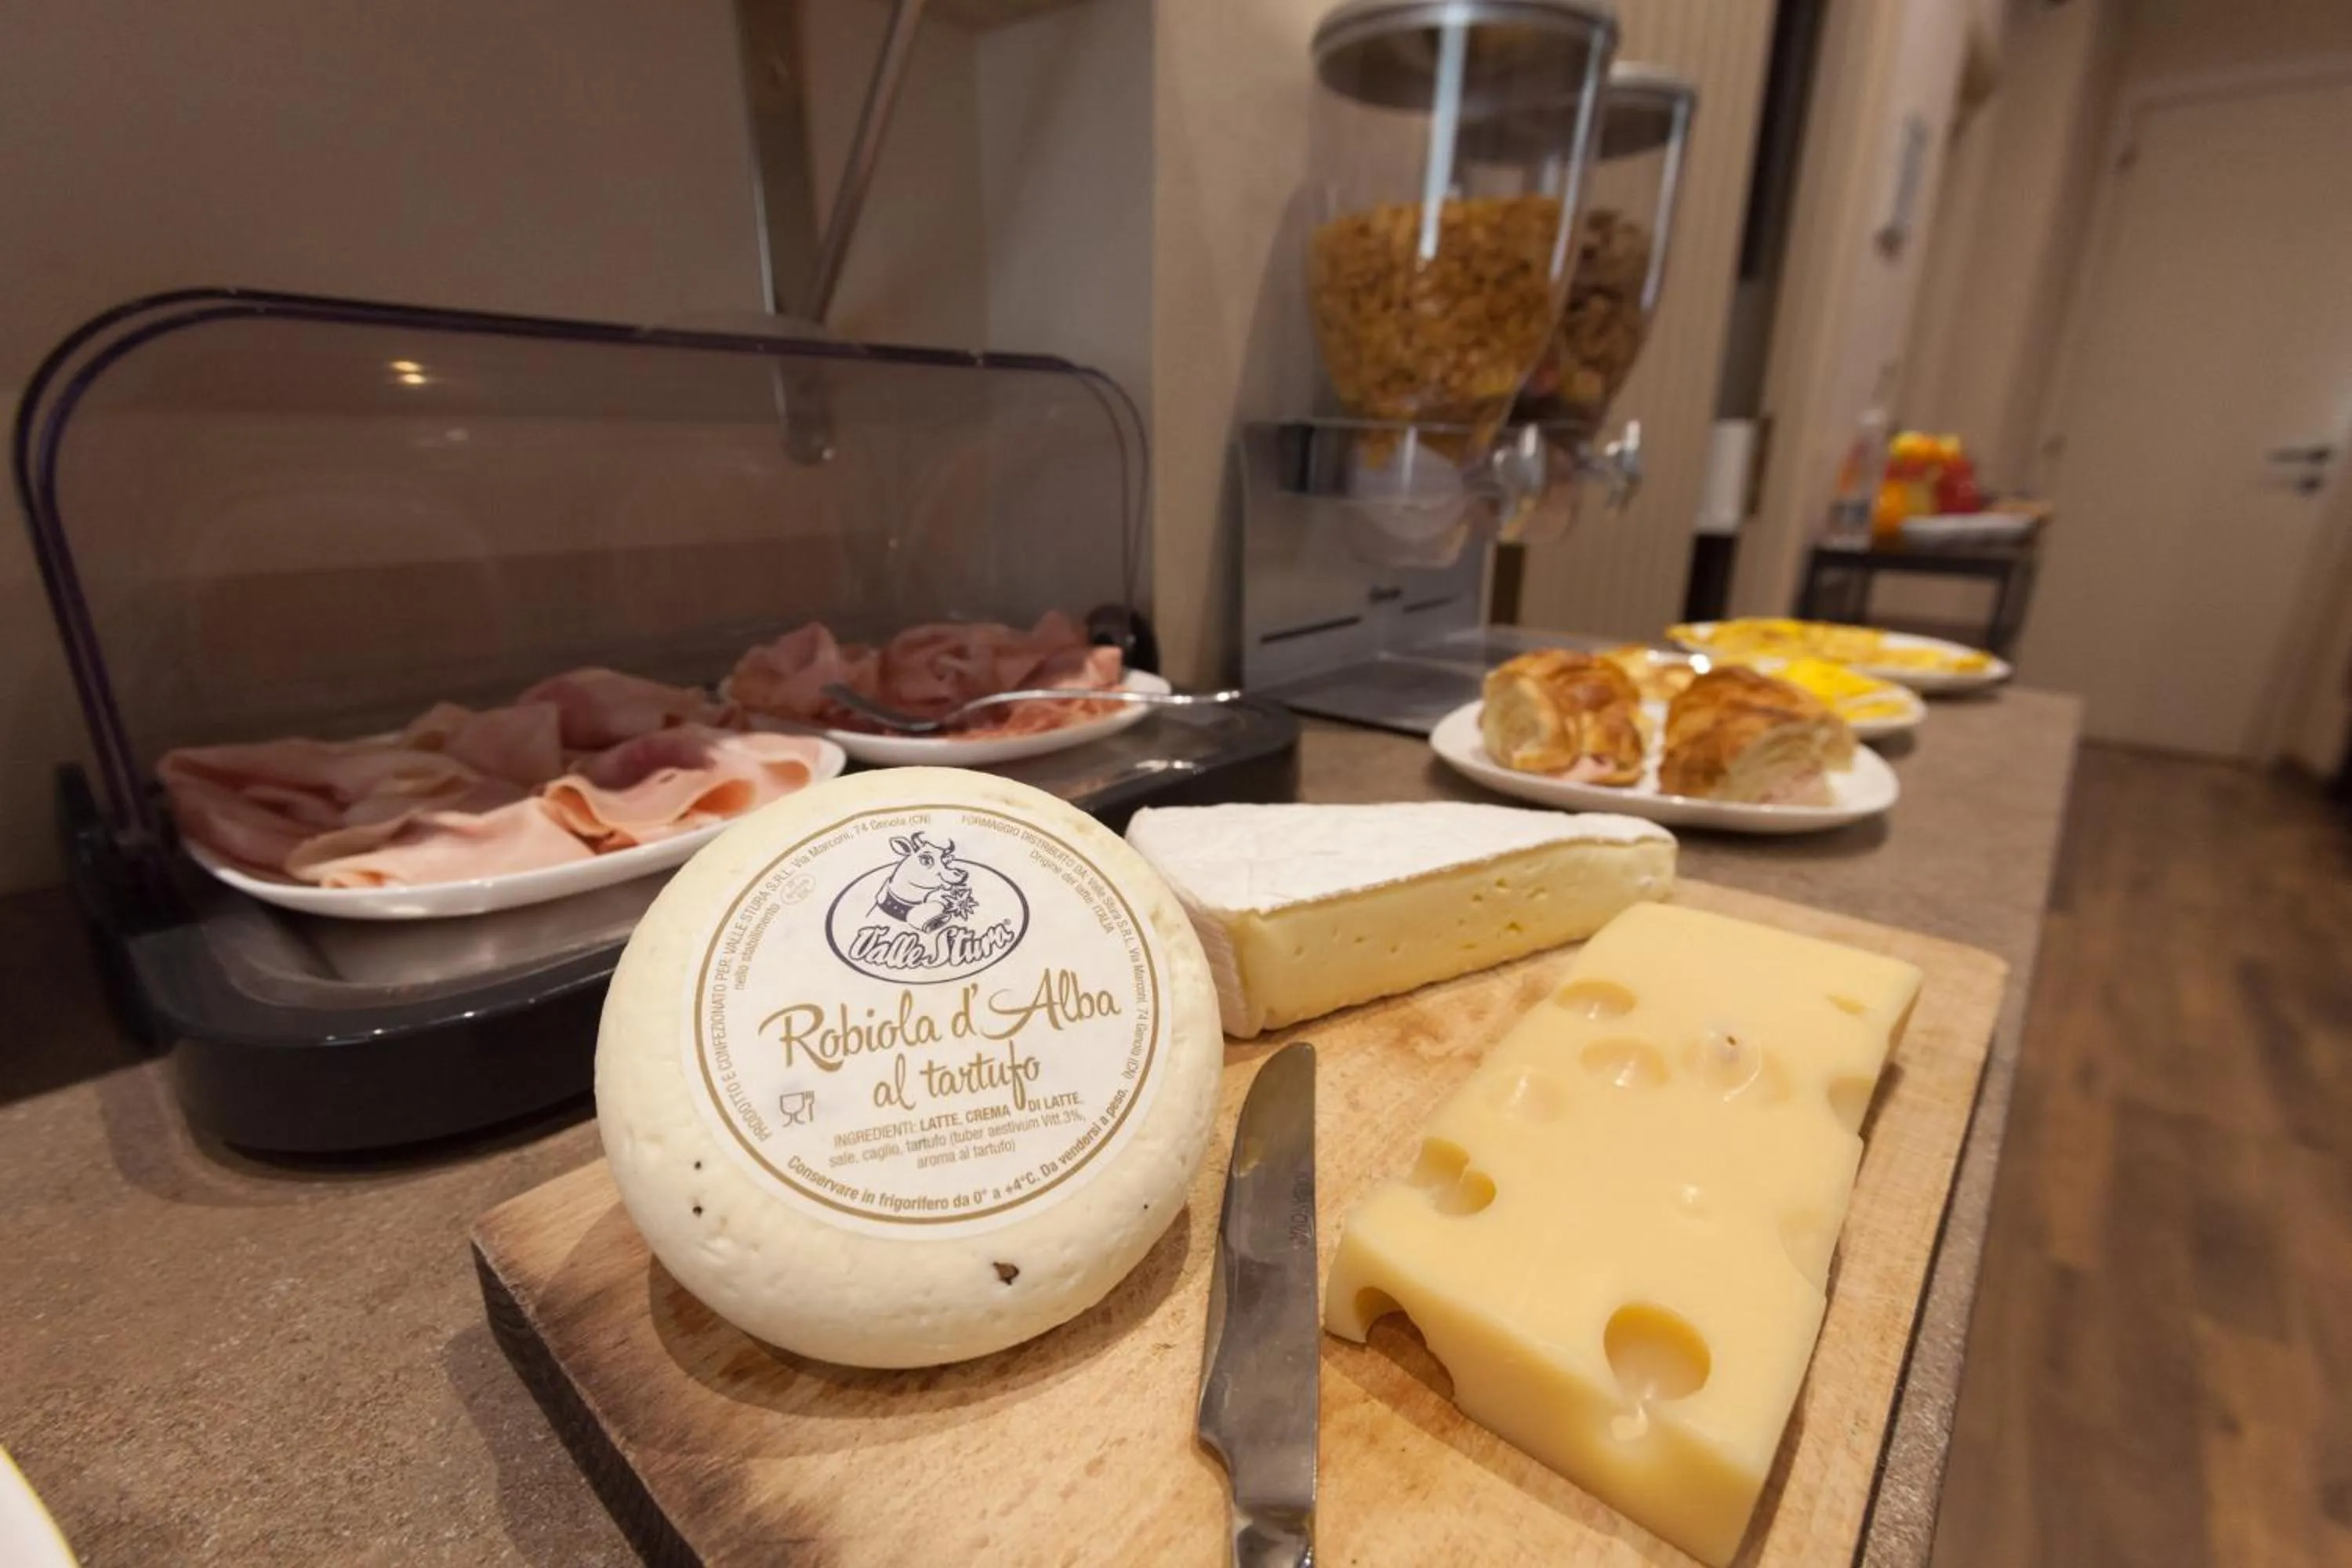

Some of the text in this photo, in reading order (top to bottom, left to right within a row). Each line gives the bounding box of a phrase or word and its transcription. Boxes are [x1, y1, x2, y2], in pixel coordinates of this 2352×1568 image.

[853, 822, 869, 835] 74
[909, 814, 931, 826] (CN)
[791, 855, 811, 868] Via
[740, 890, 771, 923] STURA
[961, 815, 1020, 837] FORMAGGIO
[1021, 830, 1075, 867] DISTRIBUITO
[1129, 947, 1141, 964] Via
[1137, 1007, 1149, 1020] 74
[1091, 905, 1116, 935] ITALIA
[724, 921, 748, 954] VALLE
[734, 902, 781, 990] nello stabilimento
[848, 922, 1014, 970] Valle Stura
[711, 984, 732, 1071] CONFEZIONATO
[757, 988, 942, 1073] Robiola
[721, 1071, 736, 1082] E
[873, 1040, 1042, 1111] al tartufo
[726, 1082, 774, 1142] PRODOTTO
[833, 1121, 917, 1149] INGREDIENTI:
[965, 1104, 1011, 1123] CREMA
[1028, 1098, 1043, 1112] DI
[787, 1155, 859, 1200] Conservare
[862, 1189, 876, 1205] in
[879, 1192, 949, 1212] frigorifero
[953, 1191, 971, 1208] da
[992, 1189, 1002, 1200] a
[1040, 1161, 1059, 1178] Da
[1058, 1122, 1102, 1165] vendersi
[1098, 1116, 1109, 1126] a
[1105, 1088, 1129, 1120] peso.
[906, 1134, 947, 1153] tartufo
[949, 1127, 983, 1147] (tuber
[988, 1117, 1040, 1137] aestivum
[916, 1141, 1016, 1169] aroma al tartufo)
